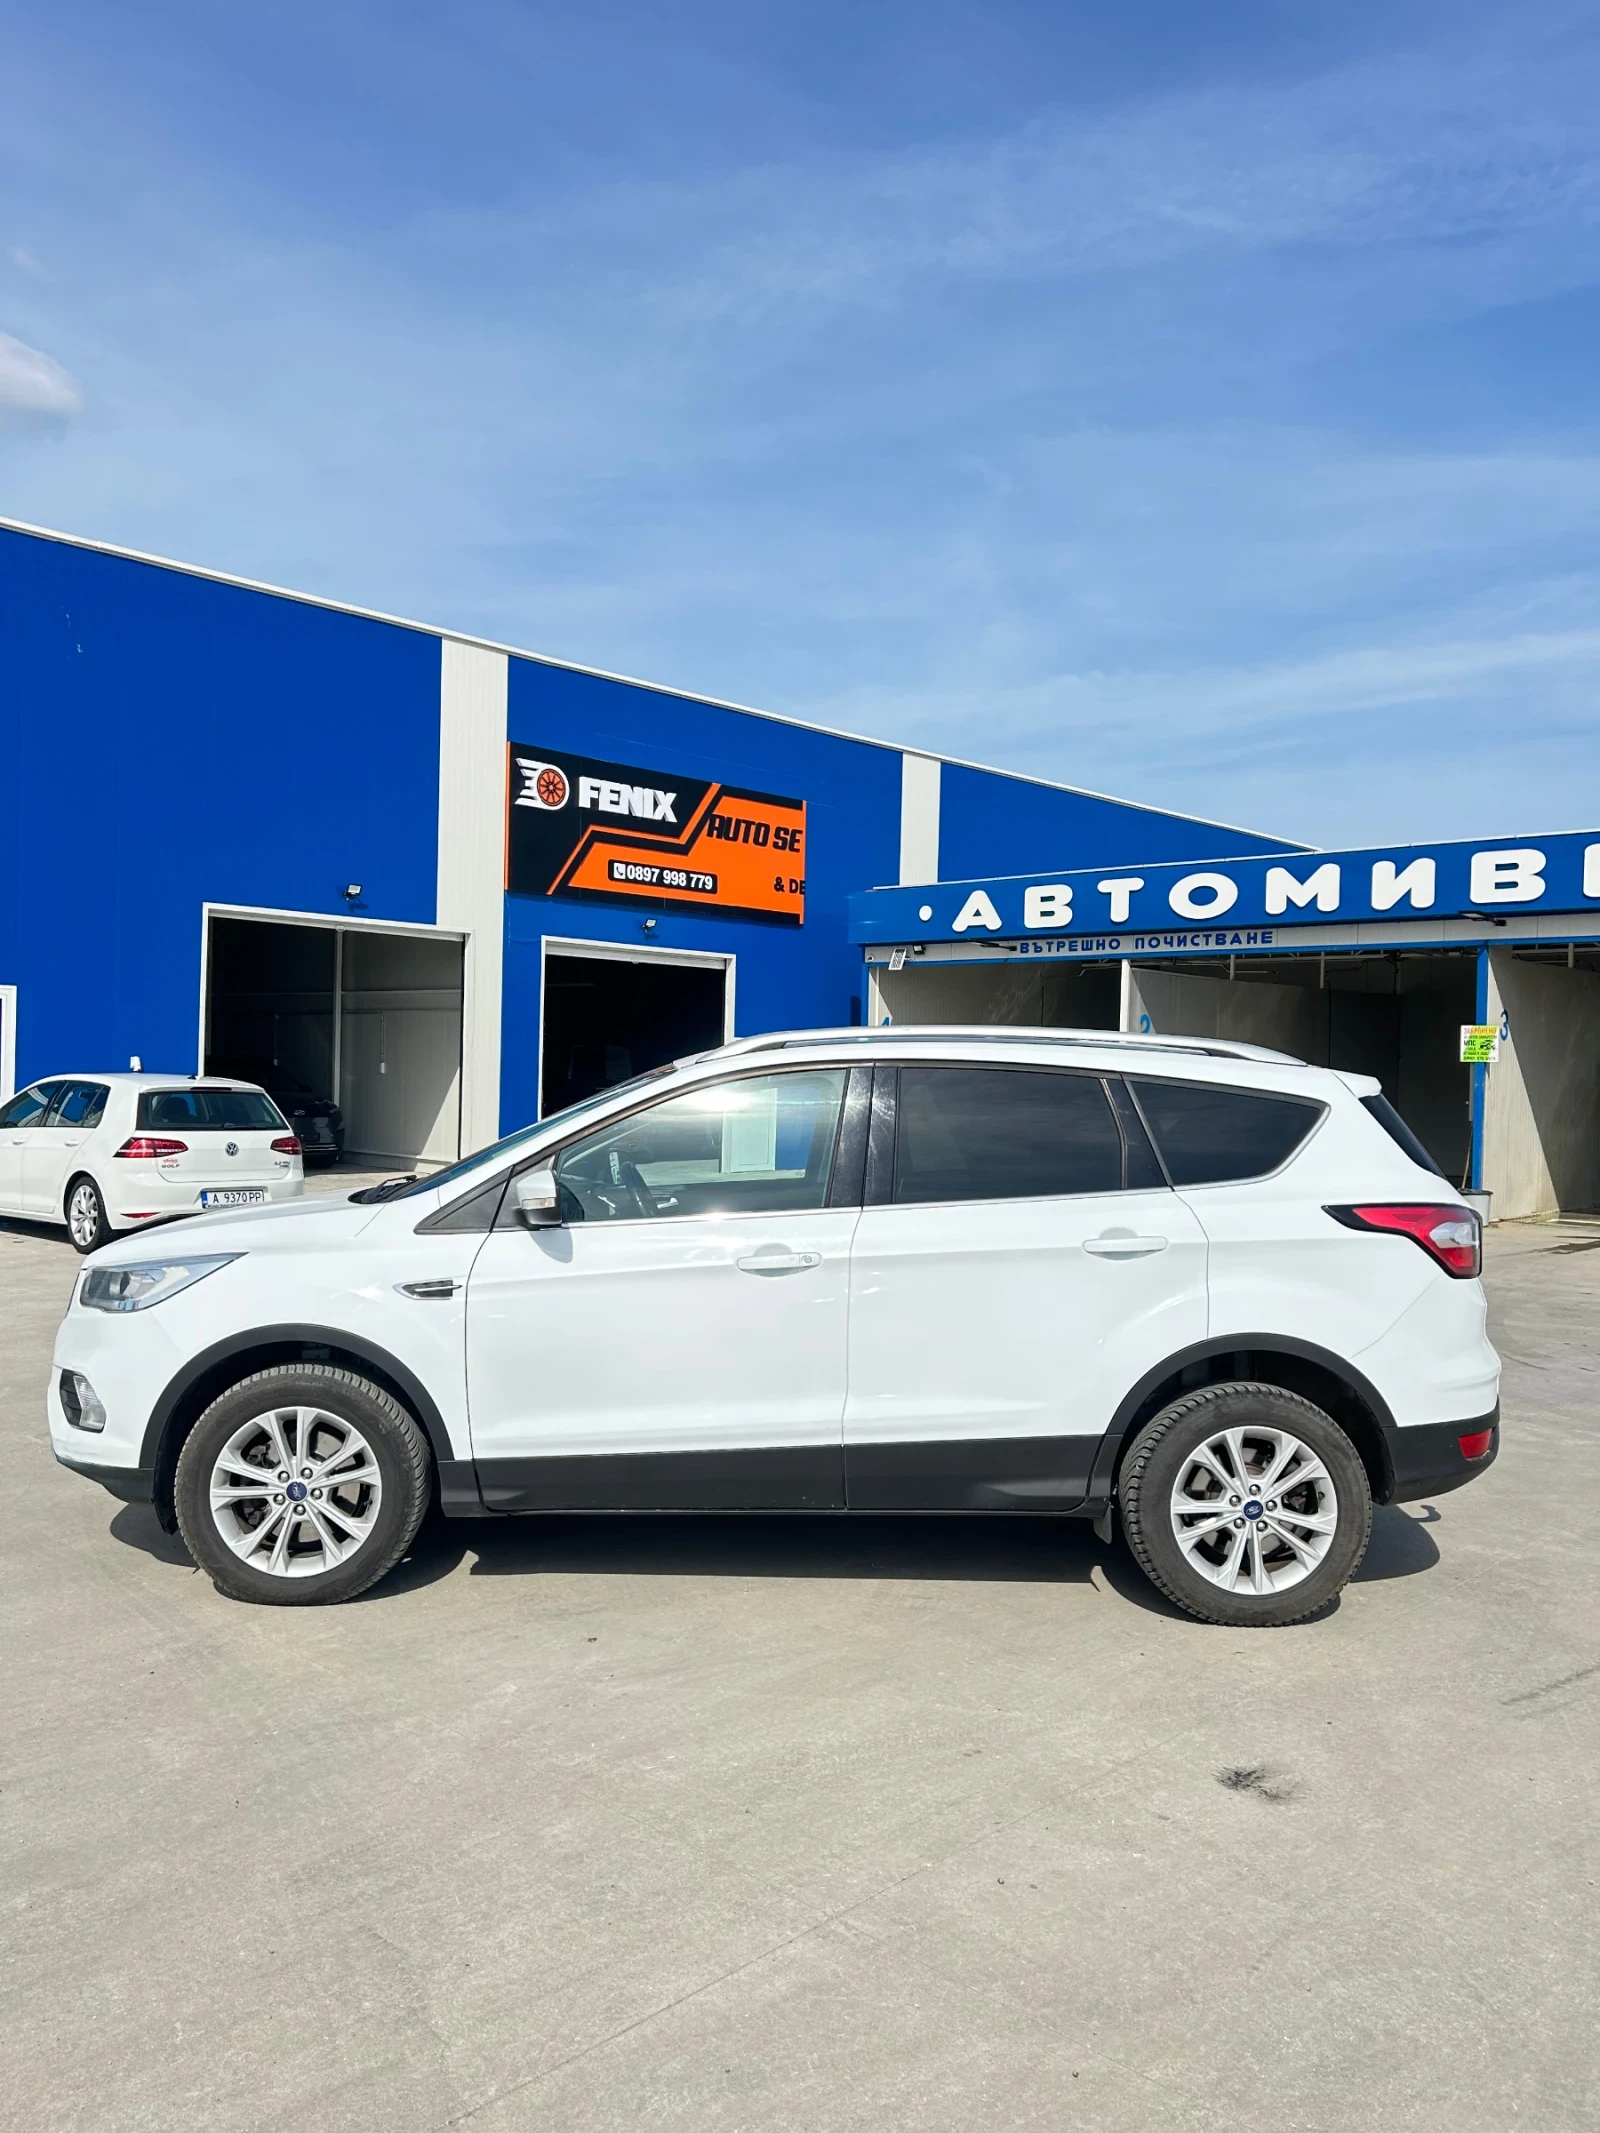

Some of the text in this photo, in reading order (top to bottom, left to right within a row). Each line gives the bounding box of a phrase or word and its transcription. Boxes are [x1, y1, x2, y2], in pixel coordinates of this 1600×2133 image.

[579, 776, 677, 823] FENIX
[707, 813, 770, 847] AUTO
[627, 865, 713, 890] 0897 998 779
[774, 876, 785, 892] &
[1020, 931, 1273, 954] ВЪТРЕШНО ПОЧИСТВАНЕ
[1500, 1009, 1508, 1041] 3
